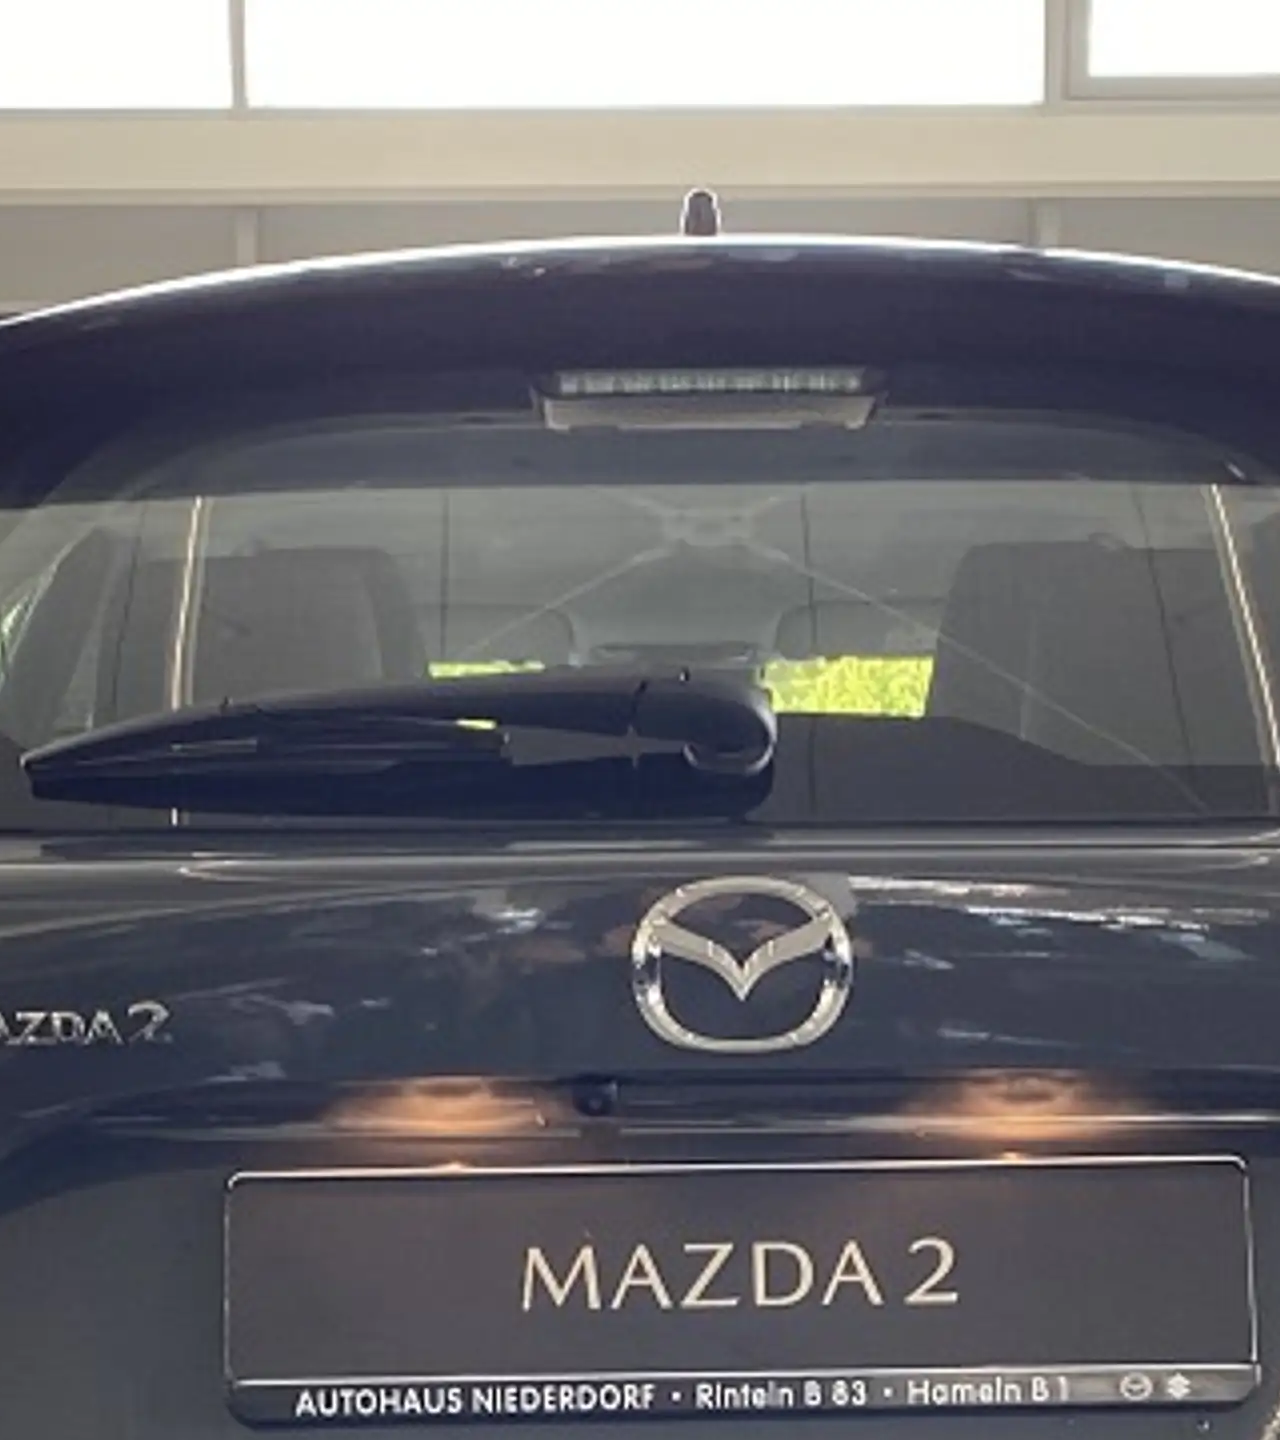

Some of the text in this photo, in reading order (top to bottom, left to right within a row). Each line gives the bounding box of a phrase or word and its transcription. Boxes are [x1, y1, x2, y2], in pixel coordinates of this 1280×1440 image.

[127, 1001, 171, 1043] 2
[522, 1238, 959, 1311] MAZDA 2
[295, 1388, 462, 1417] AUTOHAUS
[472, 1383, 656, 1413] NIEDERDORF
[804, 1383, 820, 1406] B
[832, 1380, 867, 1406] 83
[908, 1377, 1020, 1405] Hameln
[1032, 1376, 1048, 1402] B
[1058, 1376, 1070, 1401] 1
